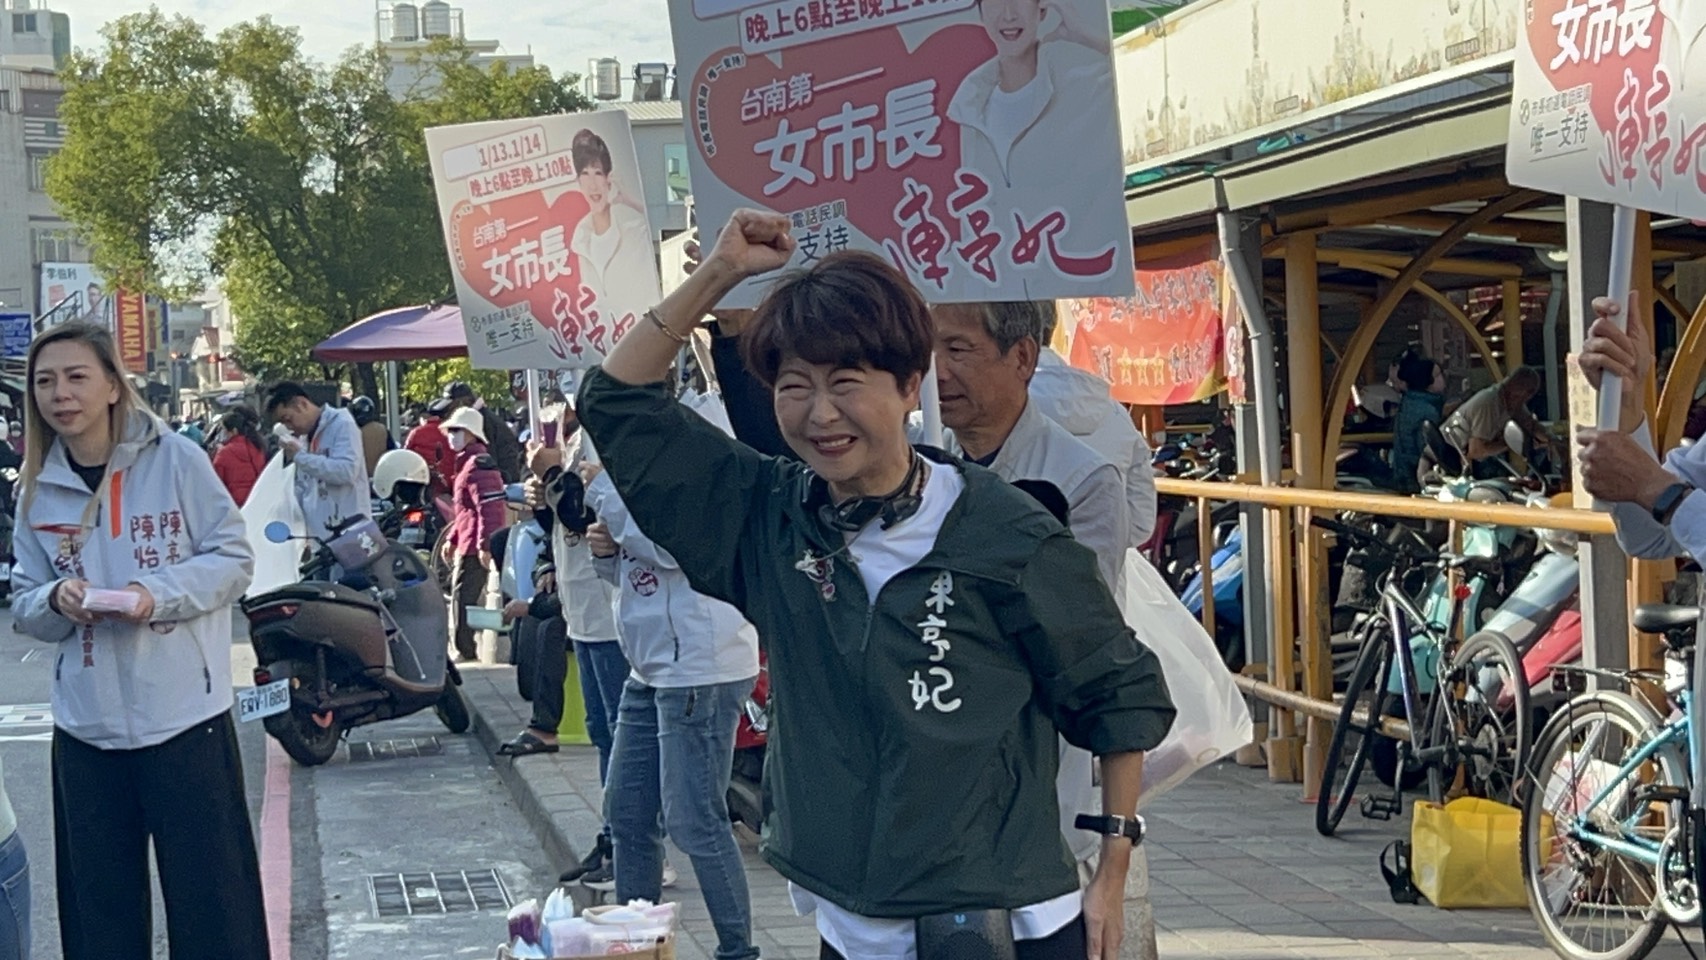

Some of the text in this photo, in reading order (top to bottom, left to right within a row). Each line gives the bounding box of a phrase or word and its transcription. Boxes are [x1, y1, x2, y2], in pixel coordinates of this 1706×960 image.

[746, 0, 958, 43] 晚上6點至晚上
[1551, 0, 1655, 70] 女市長
[741, 67, 885, 122] 台南第一
[479, 133, 542, 168] 1/13.1/14
[753, 79, 942, 196] 女市長
[1530, 111, 1589, 153] 唯一支持
[470, 155, 573, 198] 晚上6點至晚上10點
[473, 216, 540, 248] 台南第一
[788, 201, 845, 228] 電話民調
[482, 225, 572, 297] 女市長
[798, 224, 848, 265] 支持
[121, 292, 142, 360] YAMAHA
[130, 513, 160, 574] 陳怡
